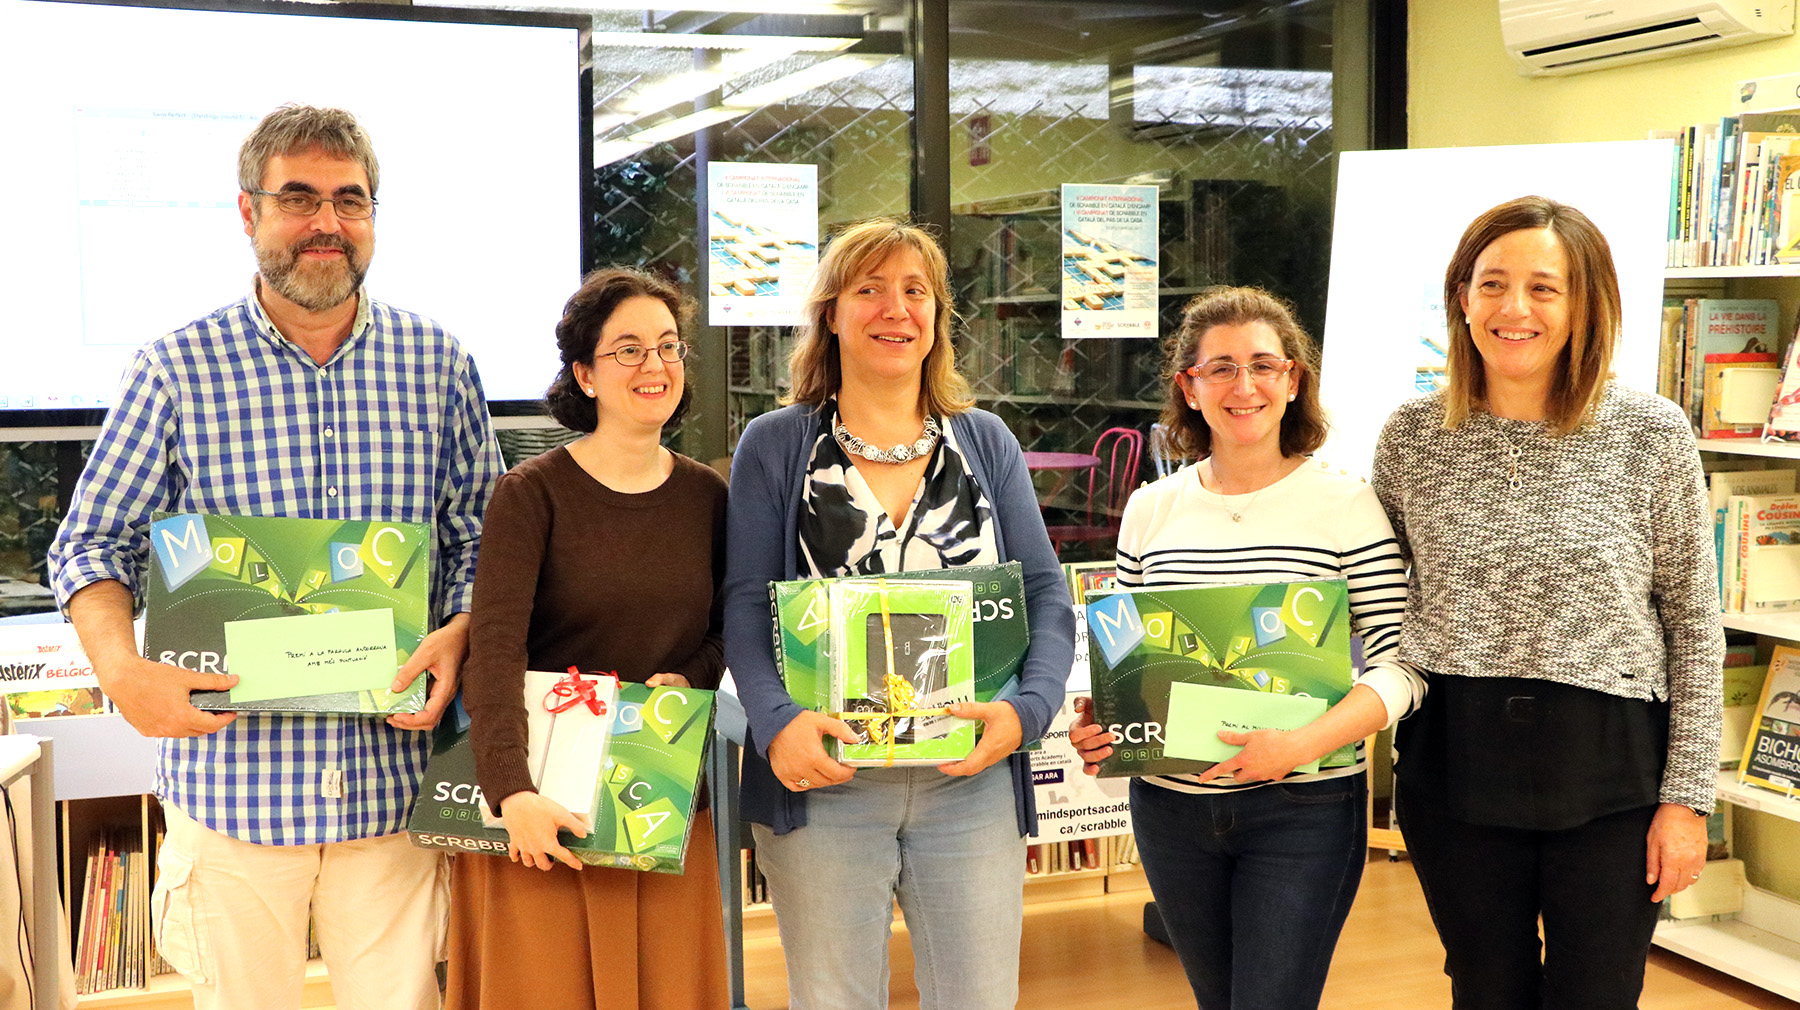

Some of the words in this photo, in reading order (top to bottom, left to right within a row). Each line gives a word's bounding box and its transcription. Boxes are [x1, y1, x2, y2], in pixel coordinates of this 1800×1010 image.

[1721, 312, 1733, 320] VIE
[1735, 312, 1756, 320] DANS
[1757, 312, 1767, 320] LA
[768, 588, 784, 676] SCRABB
[1044, 731, 1068, 740] SPORT
[1060, 818, 1127, 836] ca/scrabble
[418, 834, 509, 851] SCRABB
